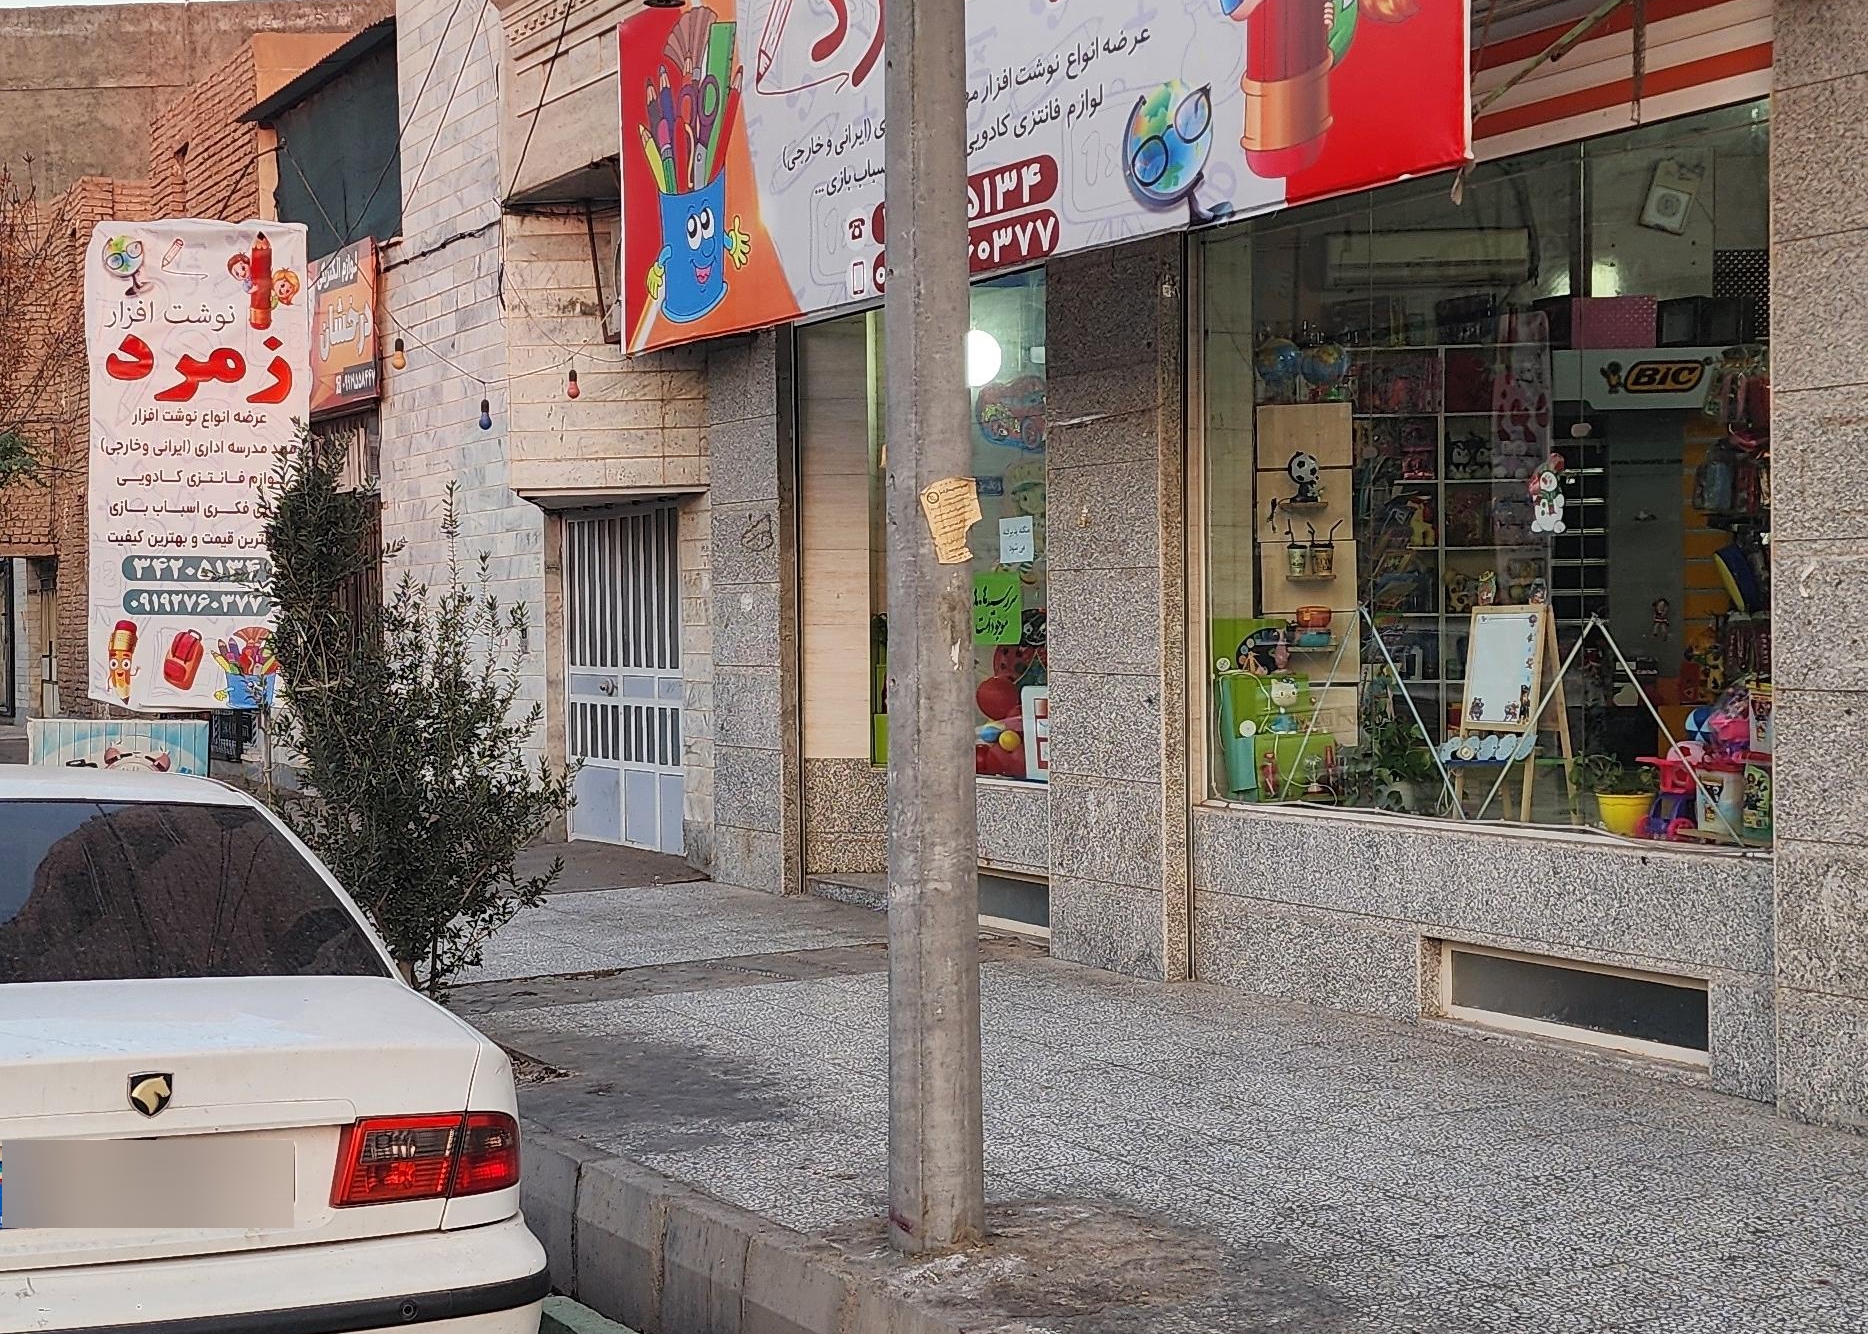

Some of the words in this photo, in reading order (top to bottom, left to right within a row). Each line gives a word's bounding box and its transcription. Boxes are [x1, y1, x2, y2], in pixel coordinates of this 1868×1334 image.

[1102, 28, 1151, 56] عرضه
[1065, 36, 1099, 80] انواع
[1016, 54, 1060, 85] نوشت
[981, 67, 1012, 104] افزار
[1067, 83, 1103, 129] لوازم
[1013, 97, 1060, 139] فانتزی
[853, 158, 886, 190] سباب
[104, 300, 154, 330] افزار
[163, 303, 236, 332] نوشت
[319, 294, 372, 362] درخشان
[105, 333, 293, 405] زمرد
[1631, 366, 1699, 387] BIC
[131, 408, 159, 425] افزار
[163, 408, 198, 427] نوشت
[201, 410, 230, 428] انواع
[233, 410, 267, 427] عرضه
[195, 440, 224, 457] اداری
[227, 444, 268, 458] مدرسه
[116, 470, 184, 487] کادویی
[187, 471, 246, 488] فانتزی
[249, 471, 284, 489] وازم
[109, 499, 149, 517] بازی
[153, 499, 200, 517] اسباب
[203, 500, 250, 518] فکری
[107, 530, 145, 547] کیفیت
[147, 531, 188, 549] بهترین
[191, 539, 198, 548] و
[202, 531, 234, 548] قیمت
[238, 532, 268, 549] ترین
[130, 592, 263, 613] ۰۹۱۹۲۷۶۰۳۷۷
